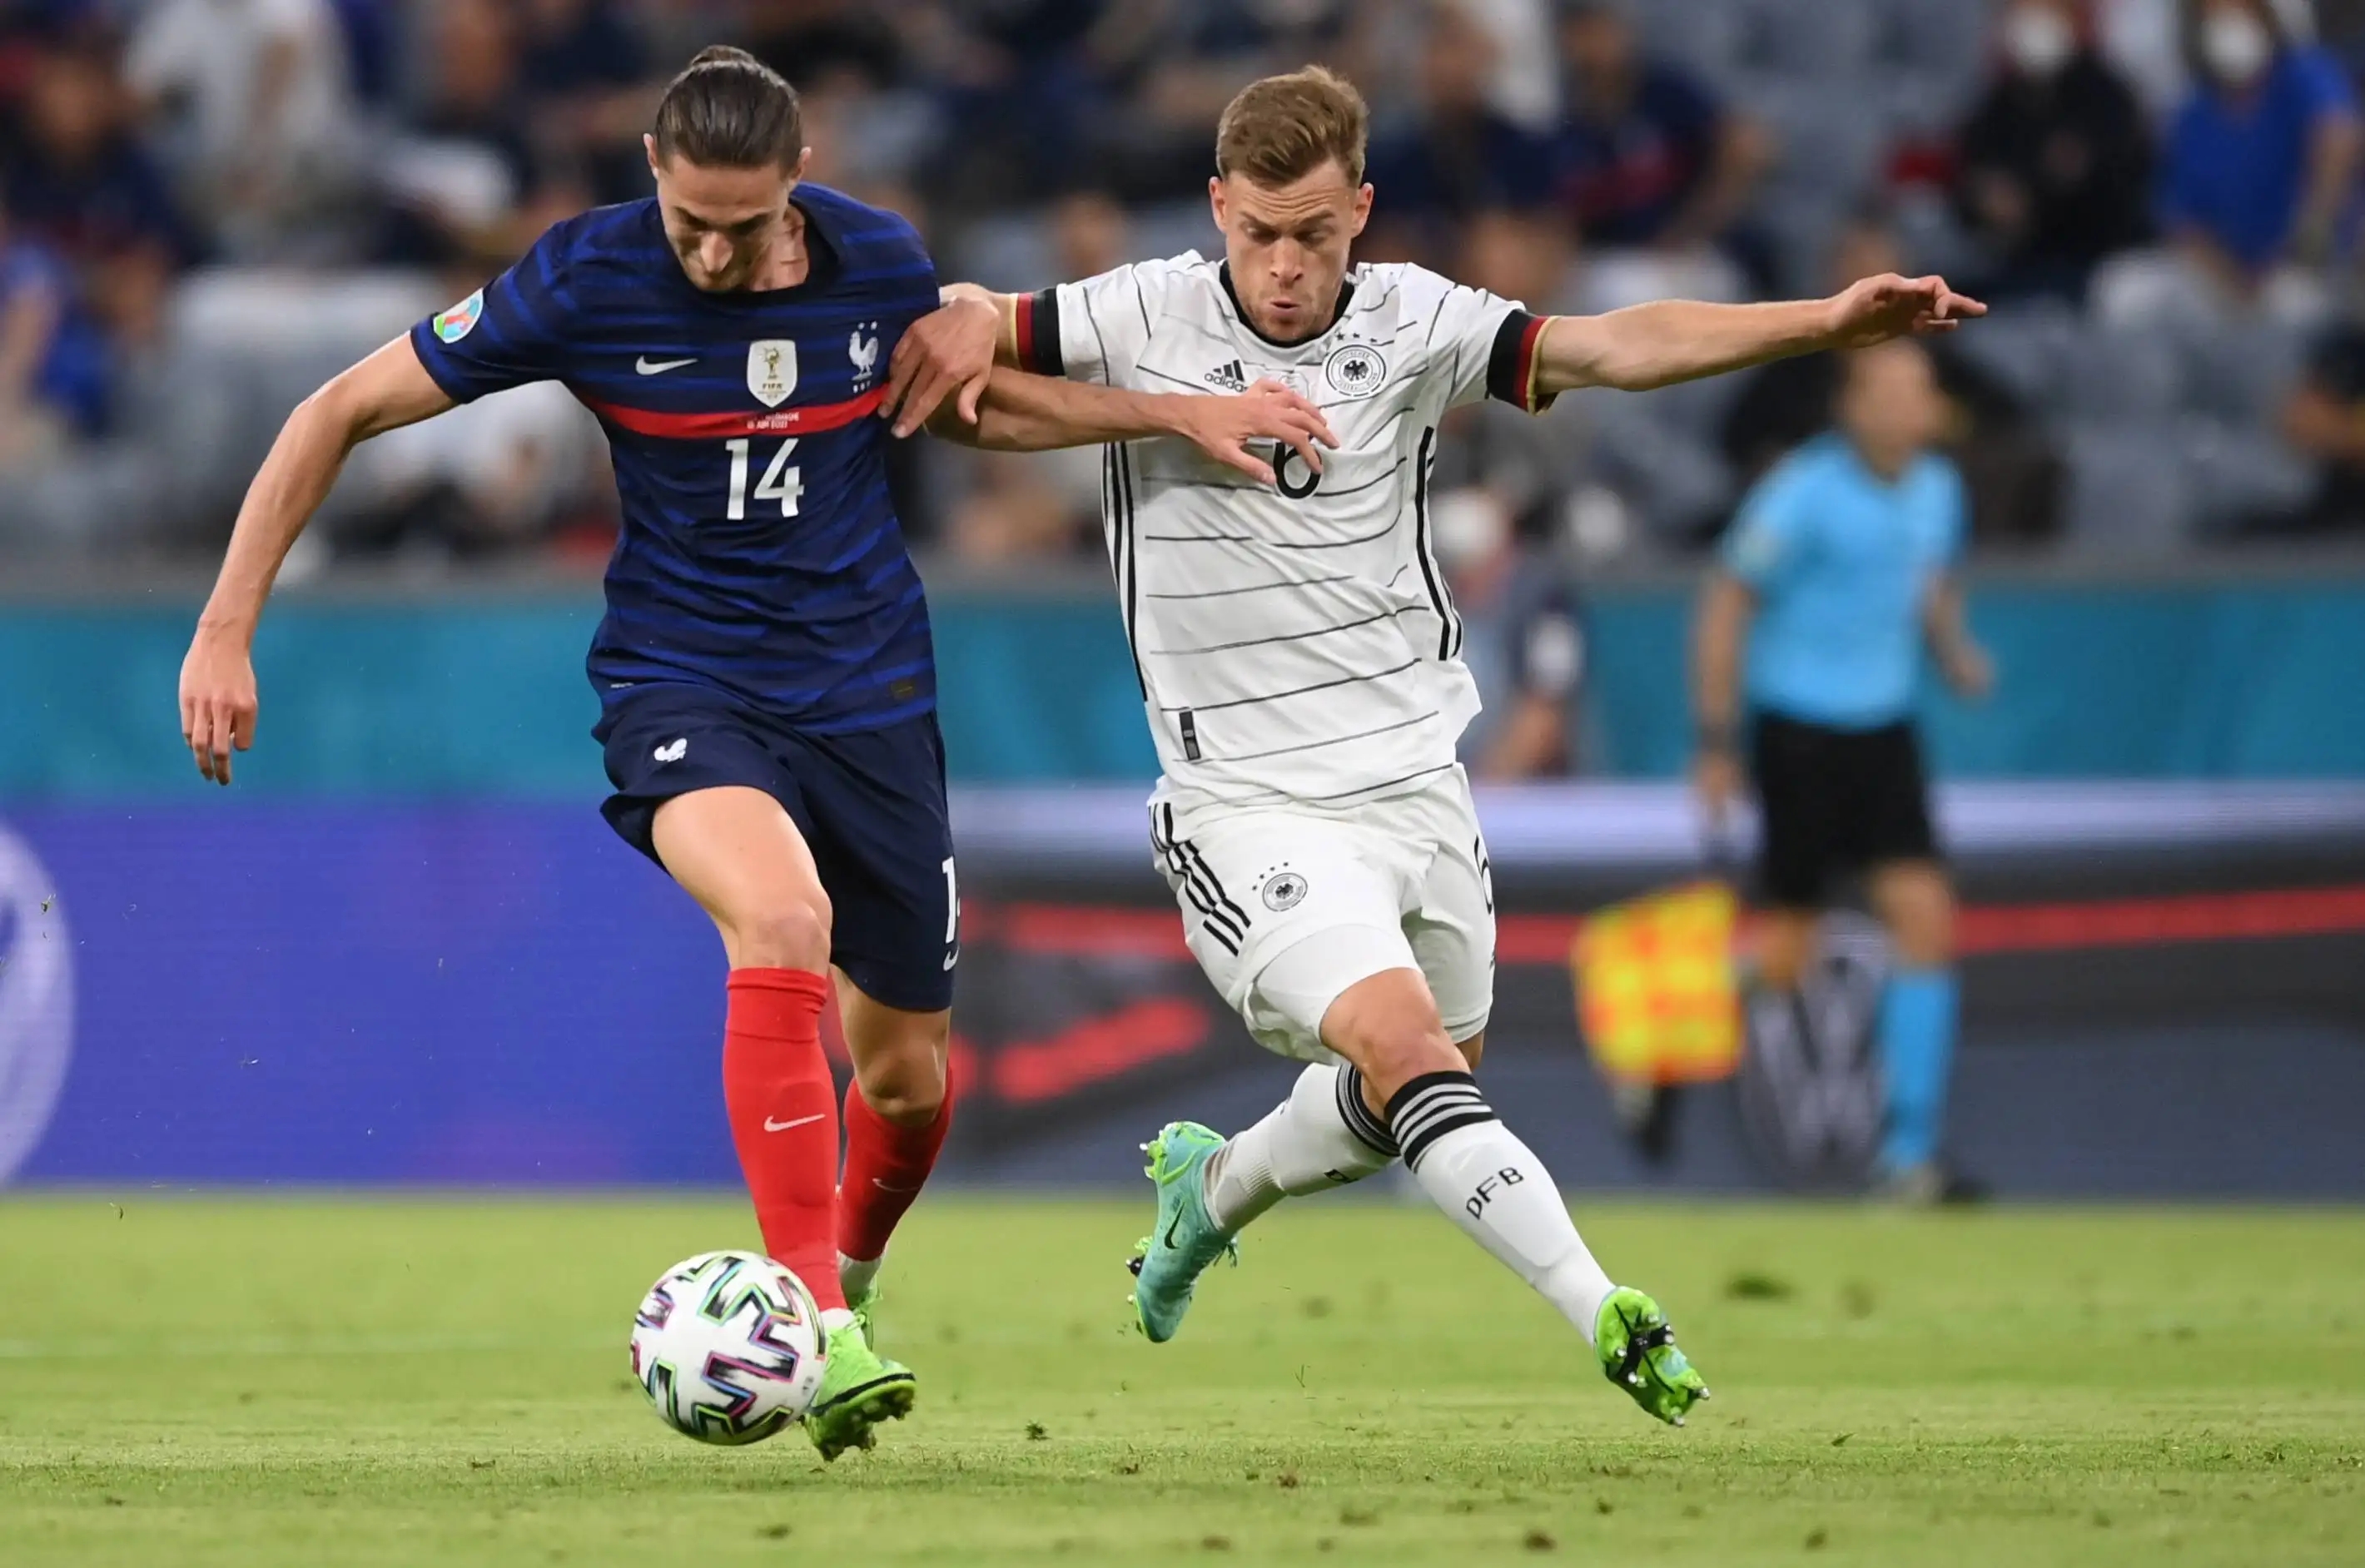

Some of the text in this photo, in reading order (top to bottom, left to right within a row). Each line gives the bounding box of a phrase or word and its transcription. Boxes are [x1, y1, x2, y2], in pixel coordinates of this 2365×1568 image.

[725, 438, 804, 520] 14
[942, 855, 961, 945] 1
[1466, 1167, 1524, 1220] DFB
